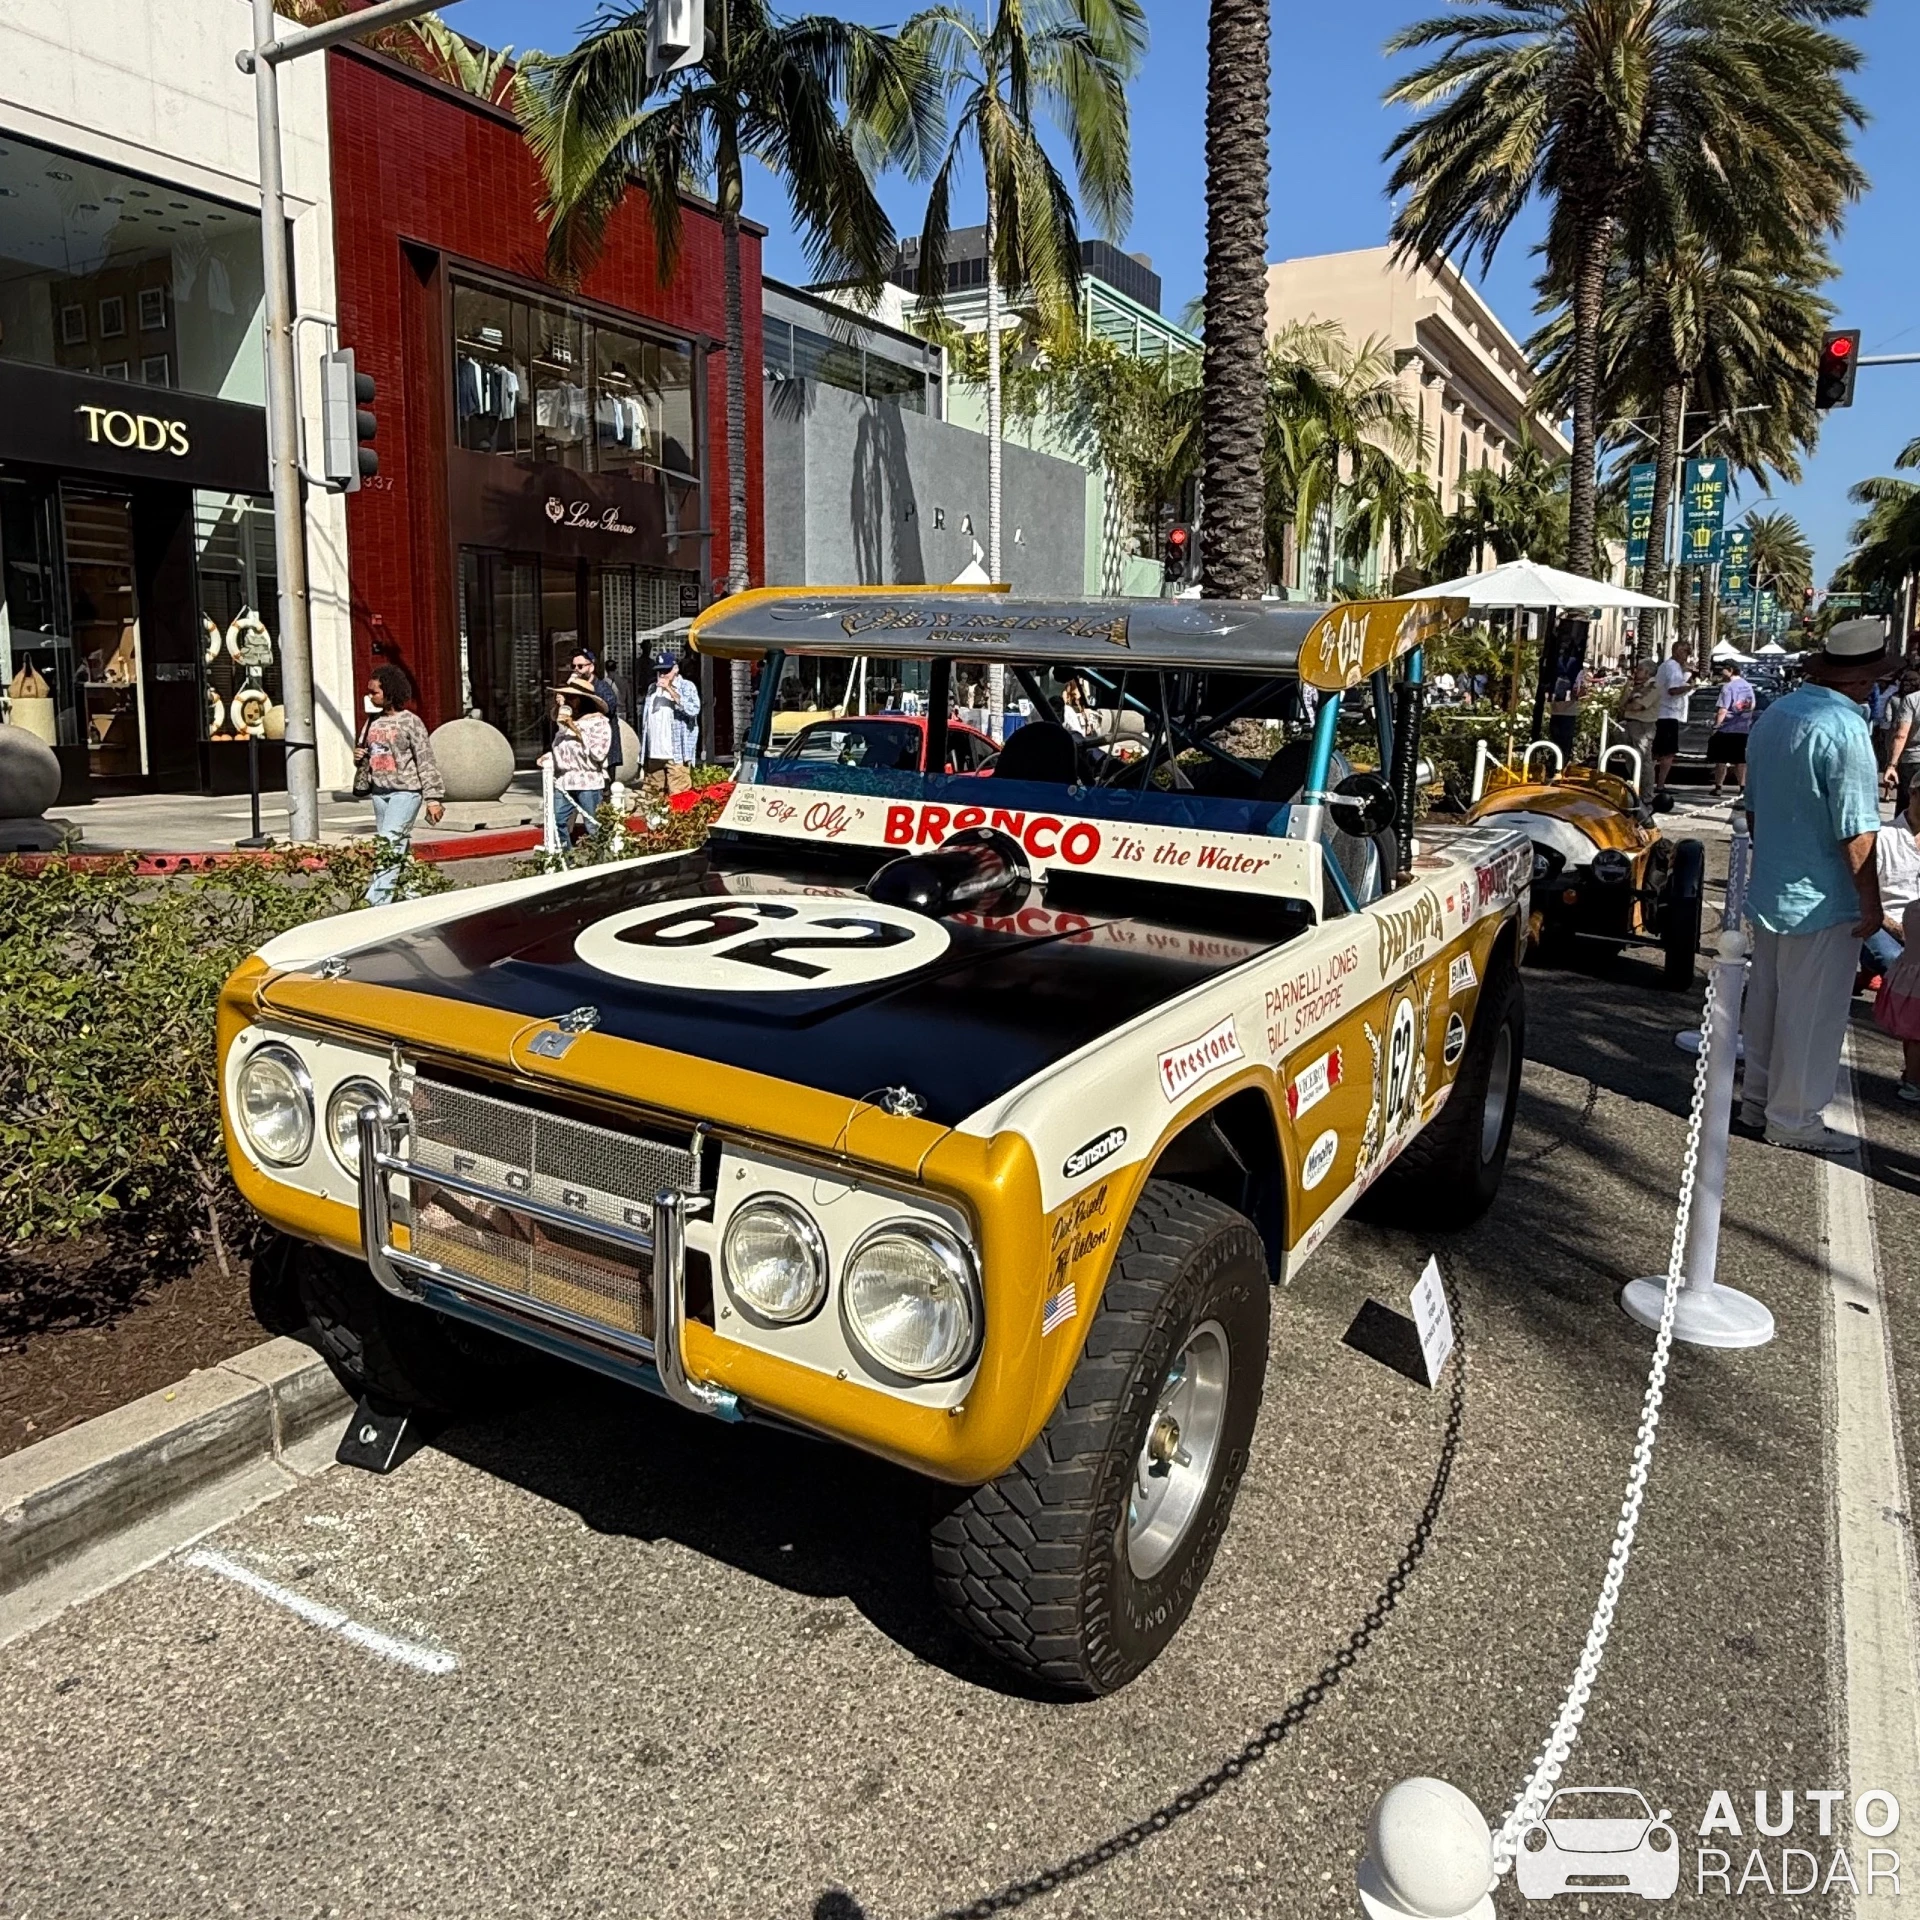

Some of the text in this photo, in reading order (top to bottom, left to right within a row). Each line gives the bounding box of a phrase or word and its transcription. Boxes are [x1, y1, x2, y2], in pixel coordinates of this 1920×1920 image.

[79, 405, 190, 456] TOD'S
[363, 475, 394, 491] 337
[1689, 482, 1722, 493] JUNE
[564, 501, 637, 534] Loro Piana
[904, 502, 1027, 547] PRAA
[1632, 516, 1651, 530] CA
[840, 606, 1131, 650] OLYMPIA
[926, 630, 1011, 644] BEER
[883, 805, 1101, 865] BRONCO
[1152, 841, 1191, 866] the
[614, 901, 916, 980] 62
[1372, 885, 1444, 982] OLYMPIA
[1402, 943, 1425, 973] BEER
[1265, 944, 1359, 1020] PARNELLI JONES
[1267, 983, 1344, 1056] BILL STROPPE
[1162, 1030, 1236, 1092] Firestone
[1387, 1019, 1411, 1124] 62
[1066, 1128, 1125, 1178] Samsonite
[1307, 1135, 1335, 1172] Minolta
[453, 1153, 651, 1230] FORD
